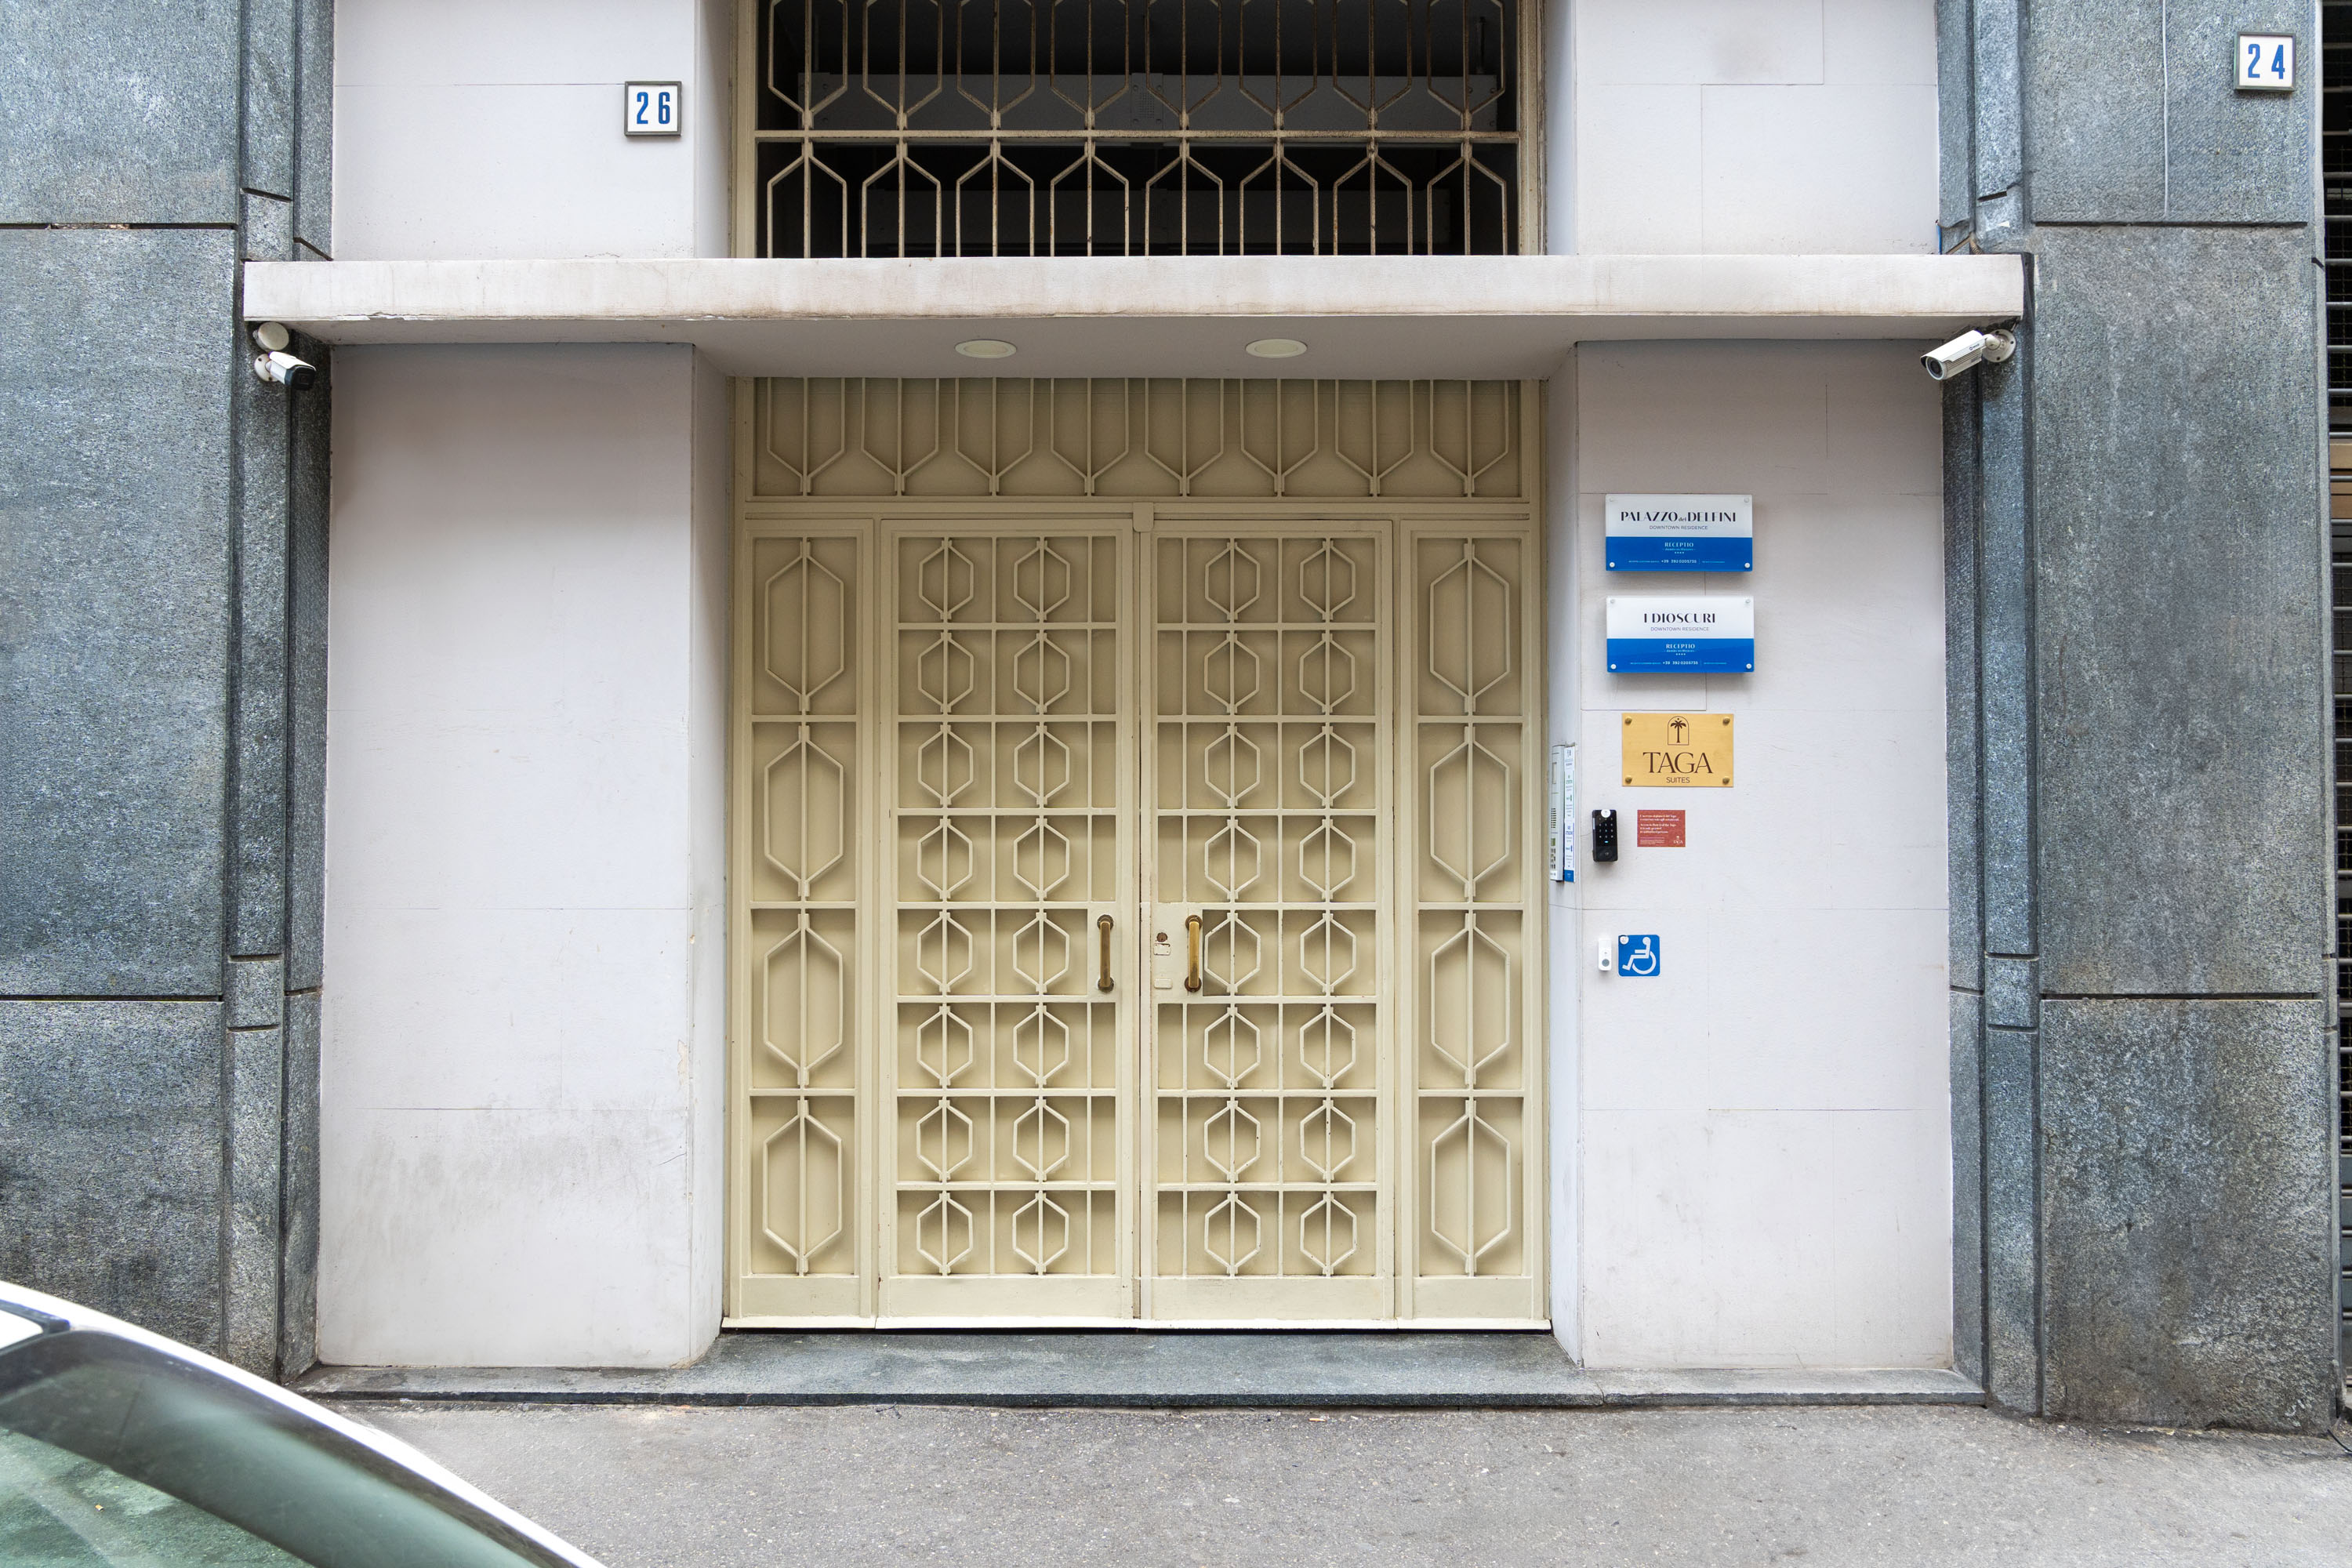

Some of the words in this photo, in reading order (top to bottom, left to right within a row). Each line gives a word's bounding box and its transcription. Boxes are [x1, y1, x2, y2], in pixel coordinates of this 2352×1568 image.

[2248, 43, 2285, 79] 24
[637, 92, 670, 125] 26
[1621, 511, 1678, 522] PALAZZO
[1687, 511, 1736, 522] DELFINI
[1644, 613, 1647, 623] I
[1652, 613, 1715, 623] DIOSCURI
[1642, 752, 1714, 774] TAGA
